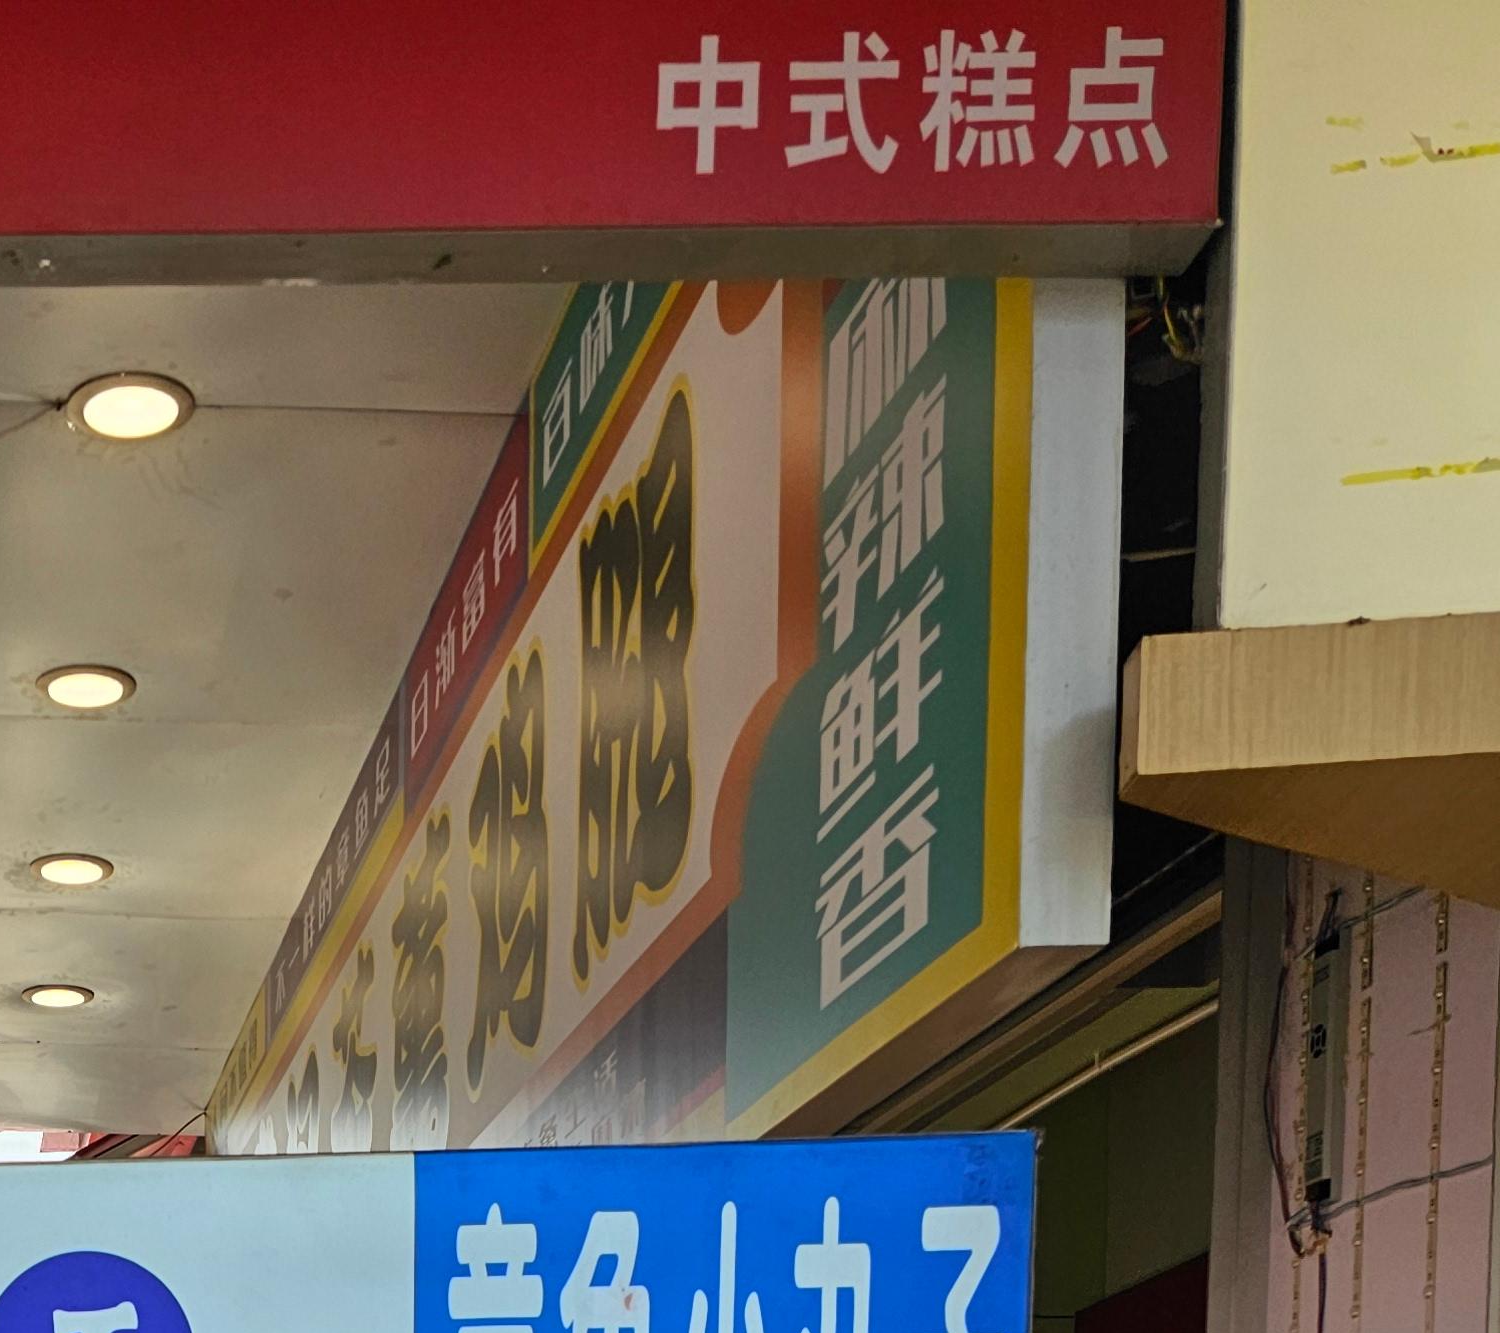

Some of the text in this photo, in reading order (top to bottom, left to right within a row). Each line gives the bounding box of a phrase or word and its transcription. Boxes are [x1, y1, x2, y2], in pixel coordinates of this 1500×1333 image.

[656, 26, 1169, 176] 中式糕点
[542, 280, 635, 491] 百味
[410, 478, 519, 760] 日渐富有
[815, 278, 948, 1012] 麻辣鲜香
[274, 736, 390, 1014] 不一样的章鱼足
